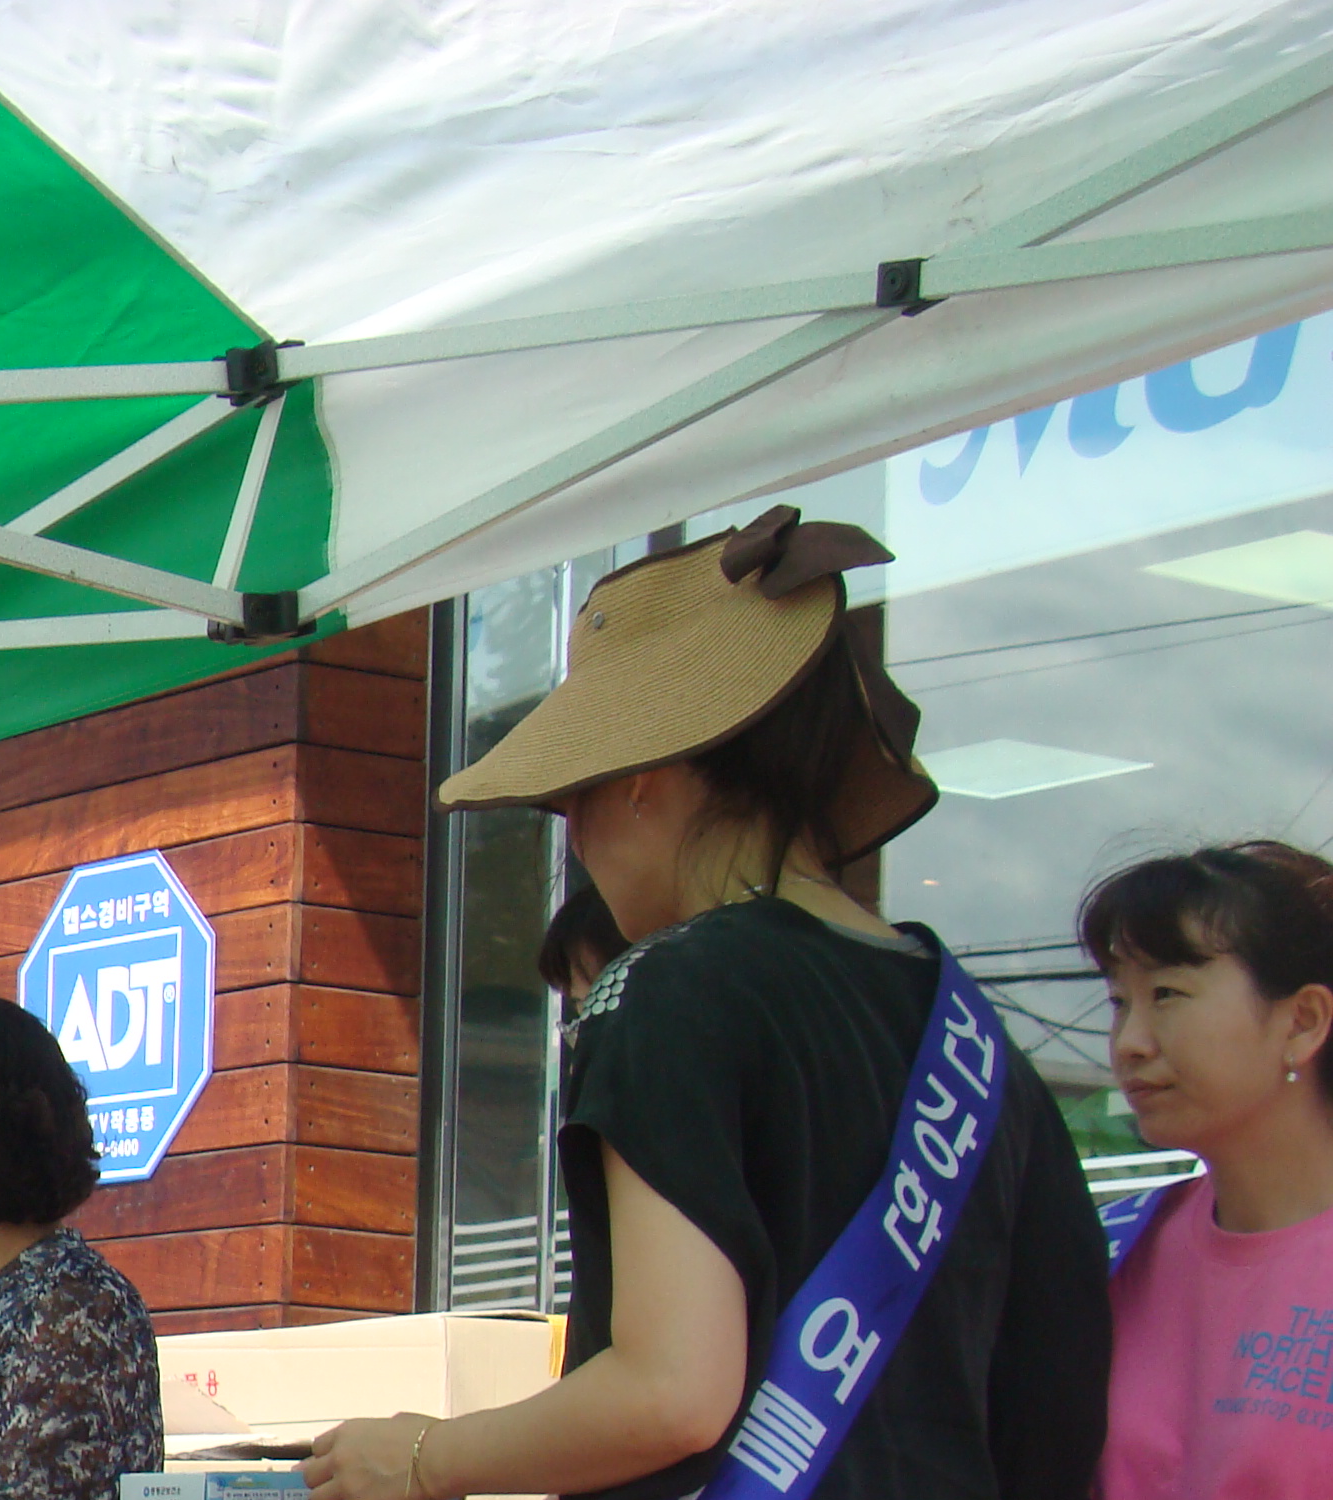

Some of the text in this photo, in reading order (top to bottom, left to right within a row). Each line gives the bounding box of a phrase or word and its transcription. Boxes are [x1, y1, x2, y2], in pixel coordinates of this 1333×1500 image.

[62, 888, 172, 936] 캡스경비구역
[57, 956, 181, 1073] ADT
[881, 990, 997, 1272] 건강한
[1233, 1330, 1332, 1369] NORTH
[1244, 1362, 1326, 1399] FACE
